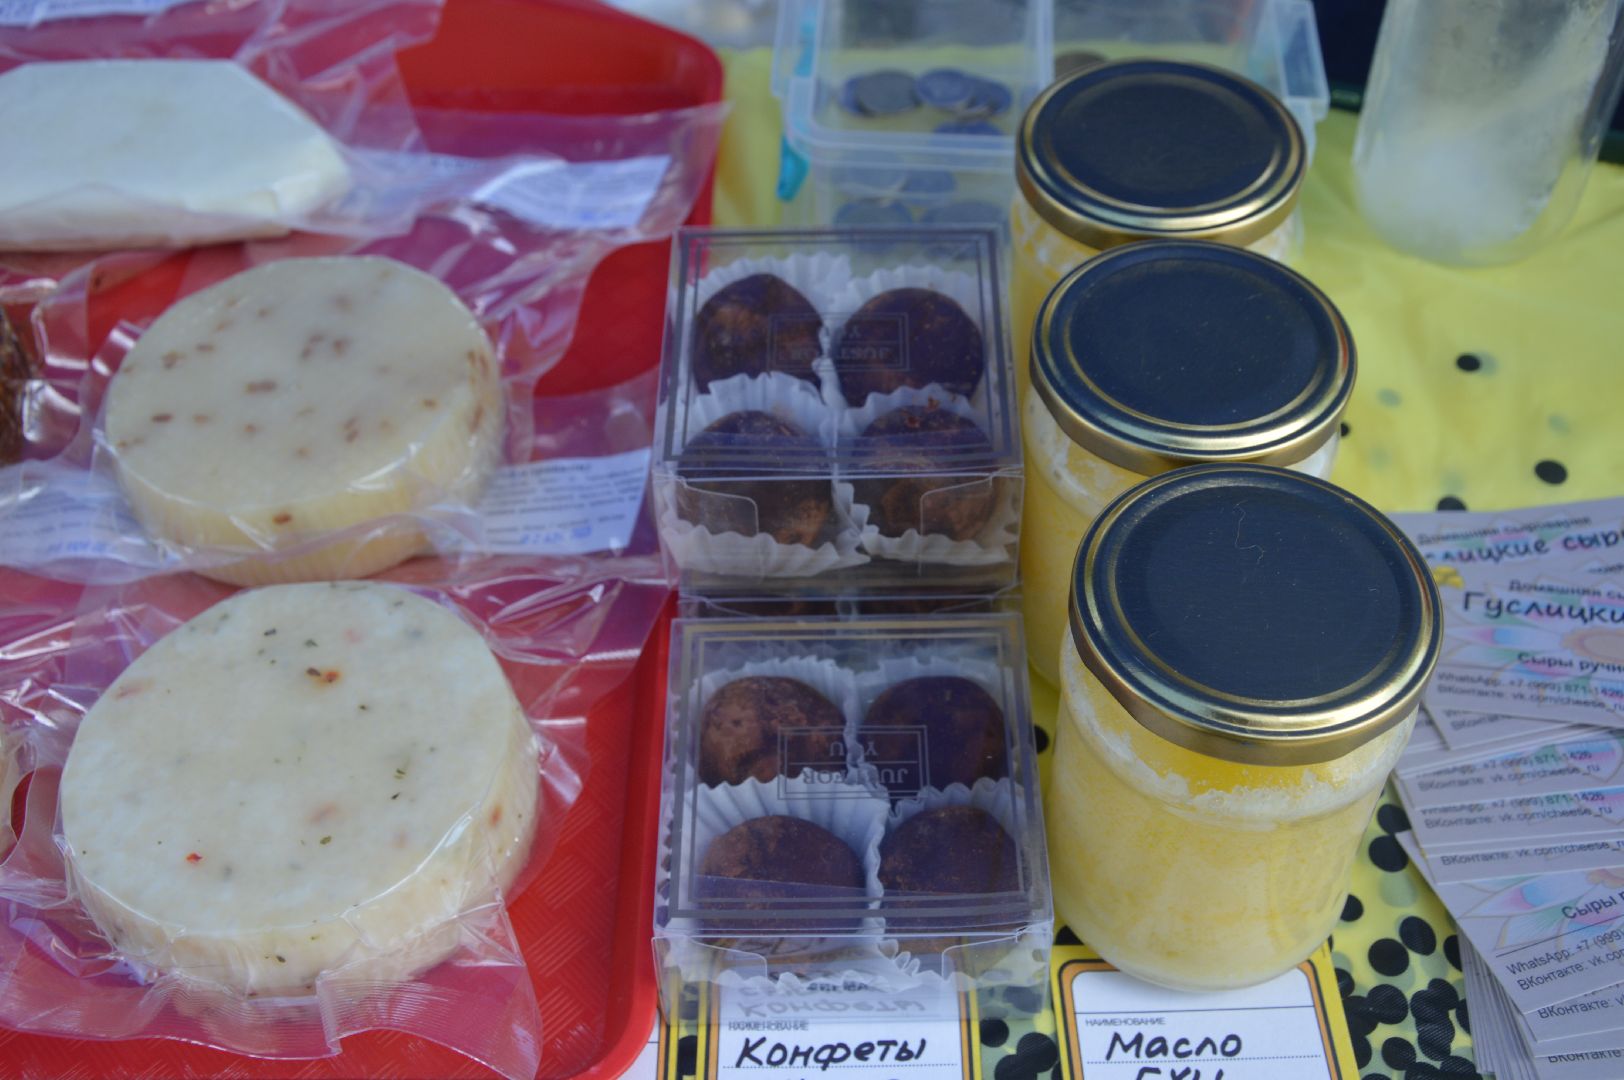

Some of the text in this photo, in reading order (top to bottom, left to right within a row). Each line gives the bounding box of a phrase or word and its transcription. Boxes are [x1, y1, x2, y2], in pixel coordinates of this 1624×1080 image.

[1425, 538, 1549, 563] лицкие
[1517, 651, 1574, 669] Сыры
[829, 740, 879, 758] YU
[1561, 895, 1618, 920] Сыры
[1505, 946, 1575, 976] WhatsApp:
[1516, 961, 1588, 991] ВКонтакте:
[1084, 1016, 1166, 1027] НАИМЕНОВАНИЕ
[735, 1036, 927, 1071] Конфеты
[1105, 1031, 1243, 1061] Масло
